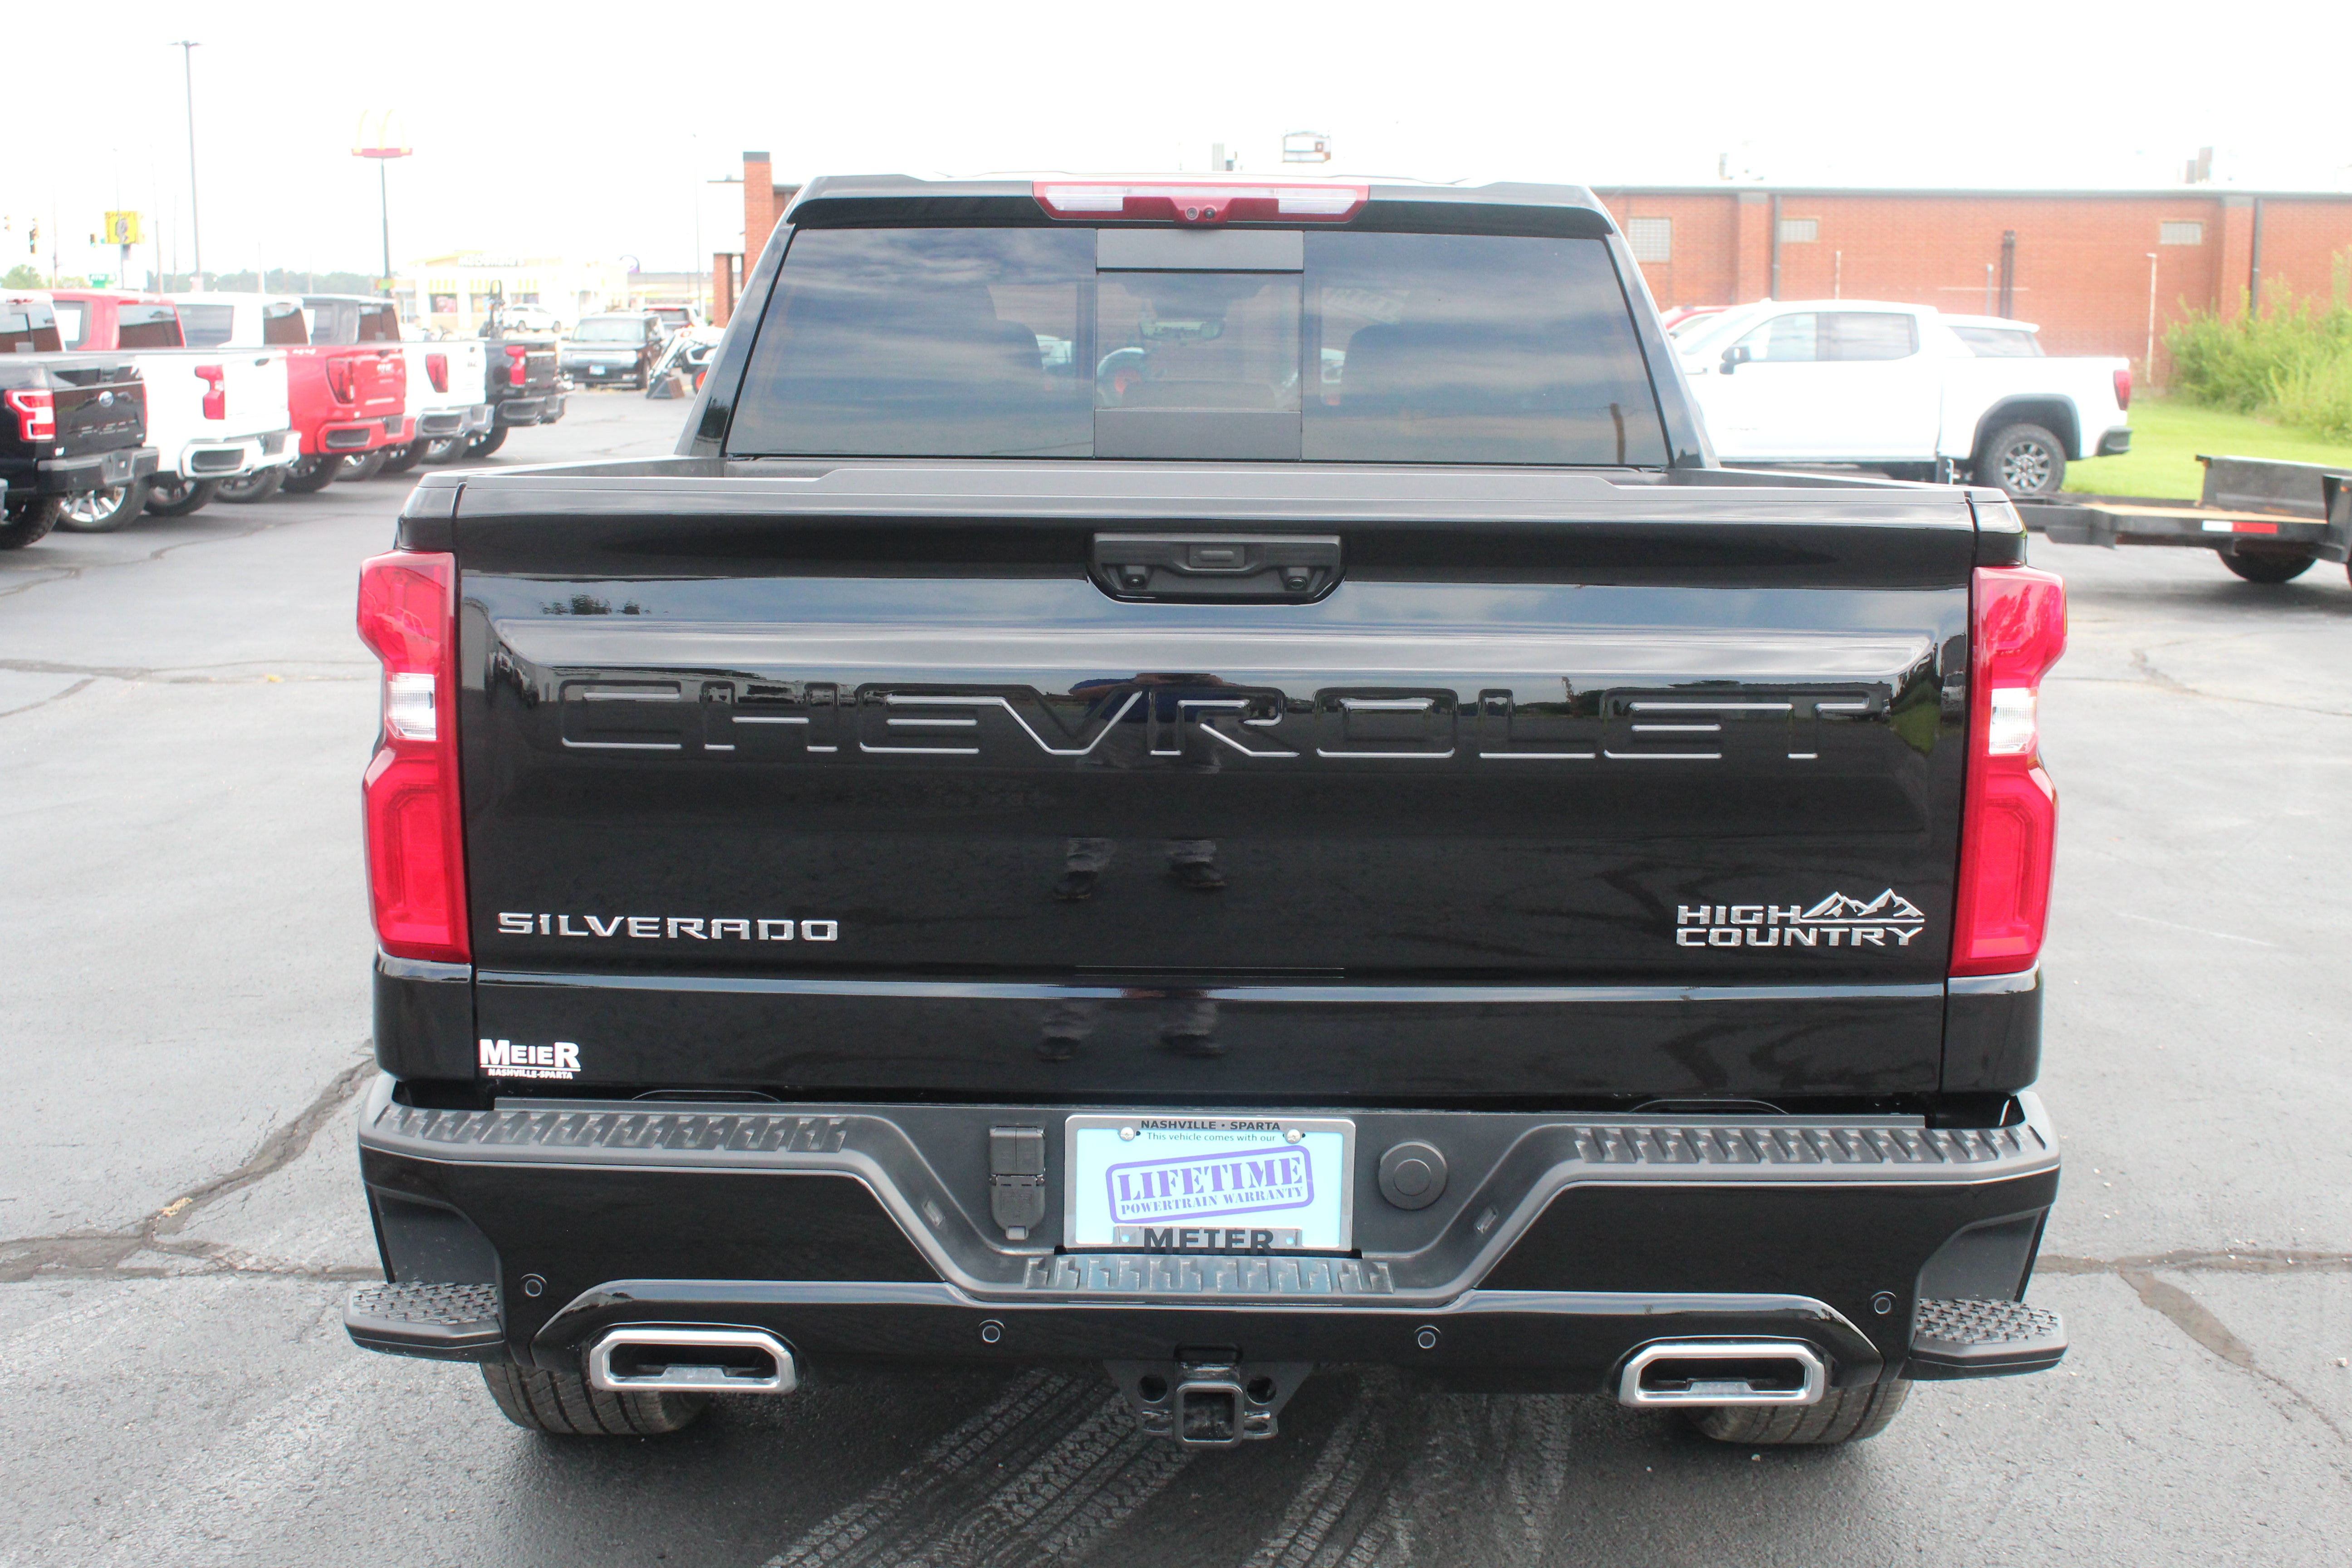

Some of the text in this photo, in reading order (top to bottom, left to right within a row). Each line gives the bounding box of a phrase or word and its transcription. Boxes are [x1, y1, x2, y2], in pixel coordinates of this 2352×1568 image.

[559, 679, 1870, 760] CHEVROLET
[497, 912, 838, 941] SILVERADO
[1676, 905, 1803, 925] HIGH
[1676, 926, 1924, 947] COUNTRY
[488, 1068, 573, 1079] NASHVILLE-SPARTA
[1141, 1120, 1281, 1130] NASHVILLE SPARTA
[1147, 1132, 1166, 1140] This
[1169, 1132, 1201, 1141] vehicle
[1237, 1133, 1257, 1142] with
[1117, 1156, 1303, 1201] LIFETIME
[1121, 1186, 1303, 1215] POWERTRAIN WARRANTY
[1144, 1228, 1277, 1255] MEIER
